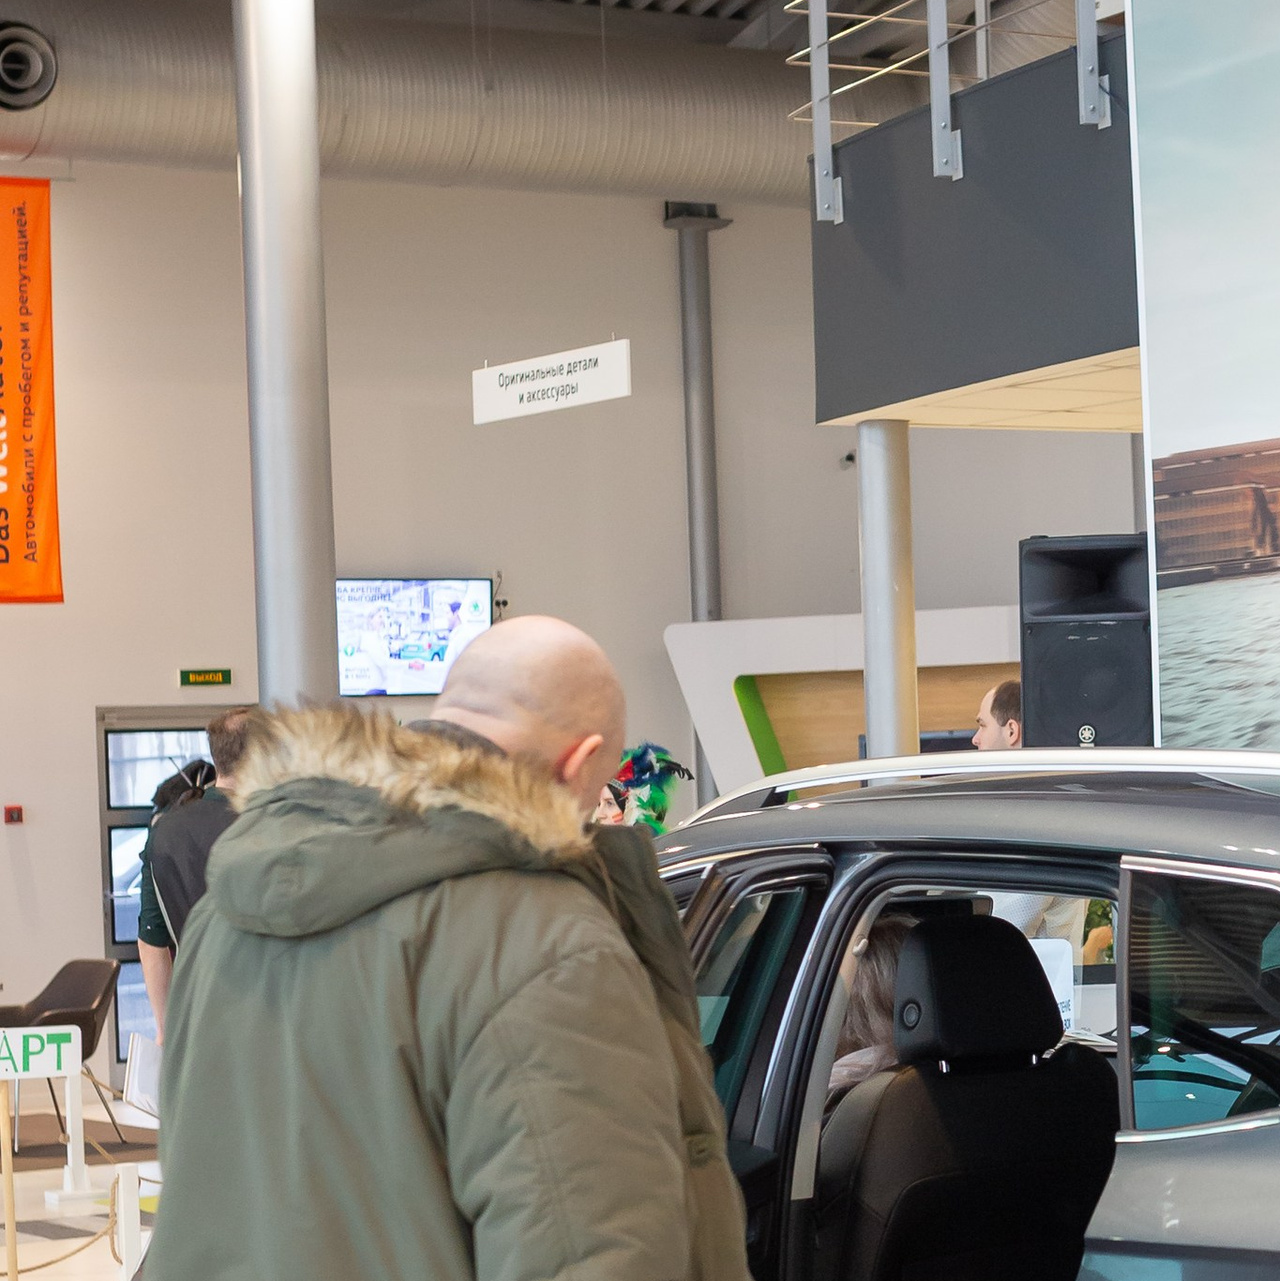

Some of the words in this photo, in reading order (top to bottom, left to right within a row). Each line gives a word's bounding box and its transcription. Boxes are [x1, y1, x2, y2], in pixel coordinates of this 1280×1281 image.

[12, 200, 33, 316] репутацией.
[20, 322, 30, 332] и
[18, 338, 35, 428] пробегом
[498, 362, 565, 391] Оригинальные
[566, 356, 599, 375] детали
[518, 392, 525, 405] и
[526, 382, 579, 403] аксессуары
[23, 434, 33, 442] с
[22, 448, 38, 563] Автомобили
